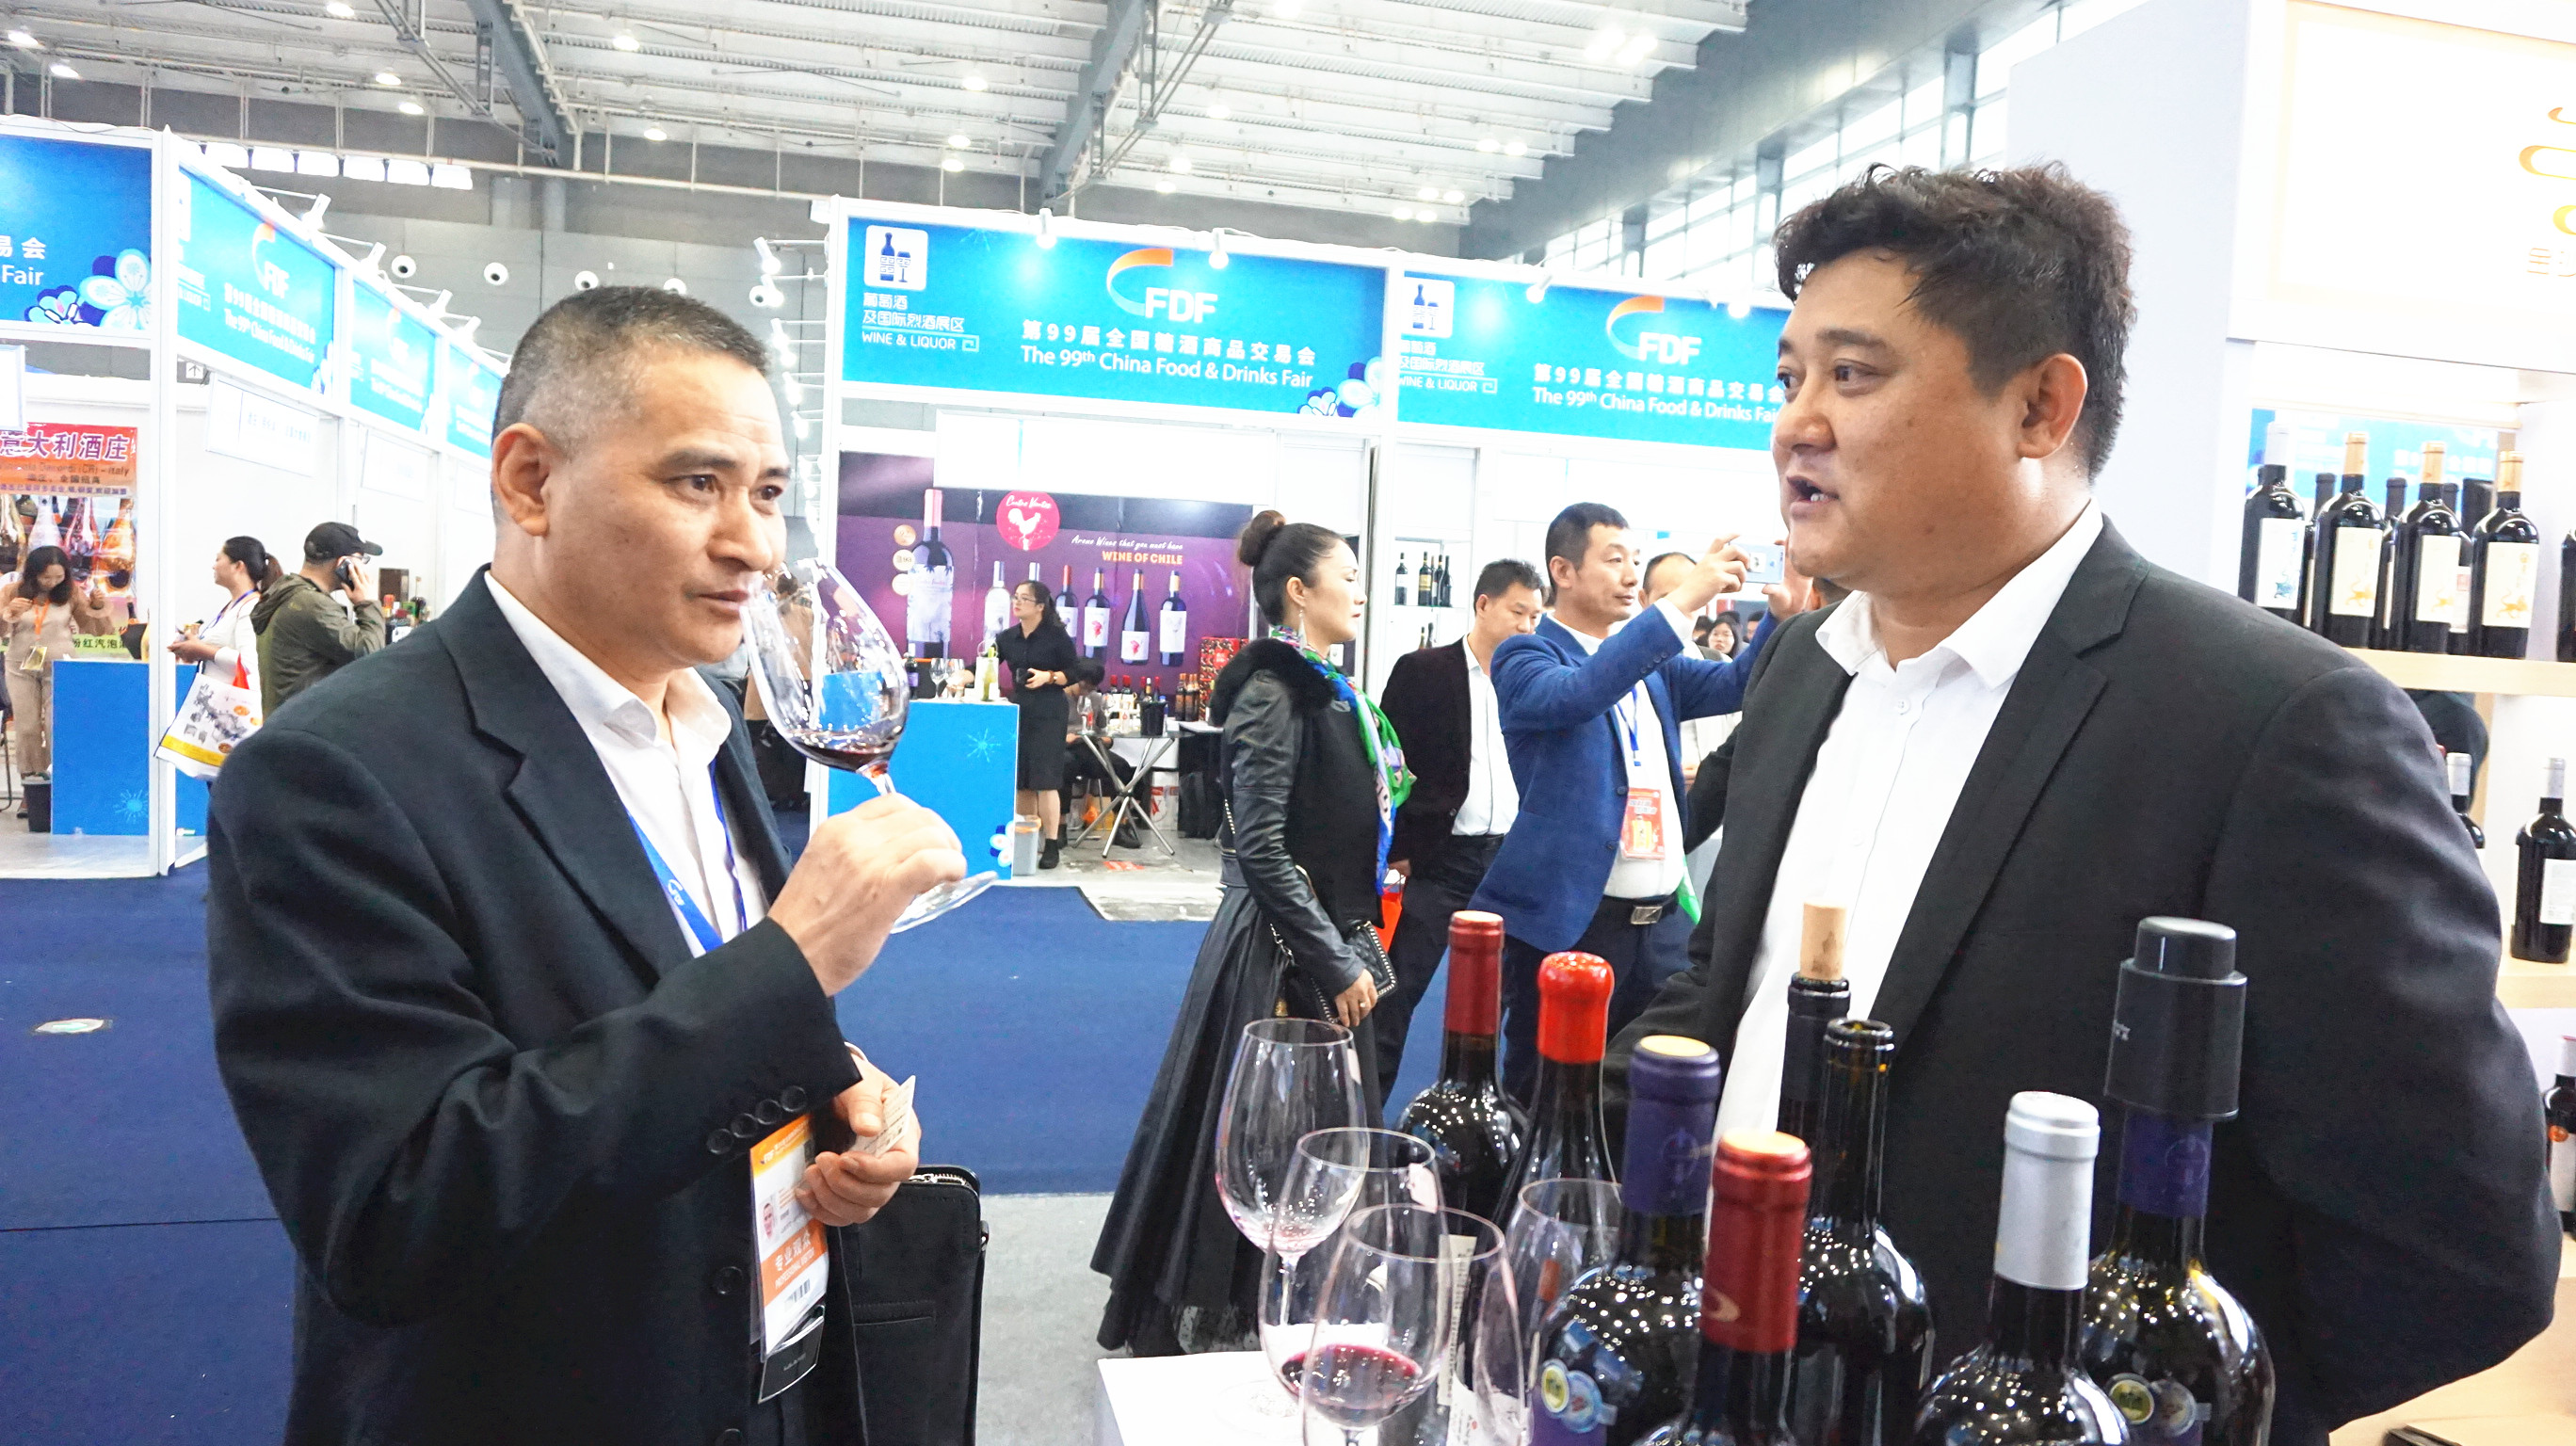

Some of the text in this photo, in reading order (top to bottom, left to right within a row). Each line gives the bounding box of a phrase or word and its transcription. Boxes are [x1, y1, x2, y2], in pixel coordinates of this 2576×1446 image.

[1, 264, 44, 285] Fair
[863, 292, 908, 310] 葡萄酒
[1144, 287, 1218, 324] FDF
[862, 310, 965, 332] 及国际烈酒展区
[862, 331, 957, 350] WINE & LIQUOR
[1022, 319, 1316, 366] 第99届全国糖酒商品交易会
[1637, 331, 1702, 365] FDF
[1021, 345, 1314, 388] The 99th China Food & Drinks Fair
[1425, 378, 1436, 389] &
[1438, 378, 1477, 392] LIQUOR
[1533, 386, 1563, 404] The
[1567, 390, 1597, 407] 99th
[1600, 393, 1646, 411] China
[1649, 396, 1687, 415] Food
[1690, 402, 1702, 416] &
[1705, 402, 1752, 421] Drinks
[1119, 538, 1135, 547] that
[1102, 550, 1183, 565] WINE OF CHILE
